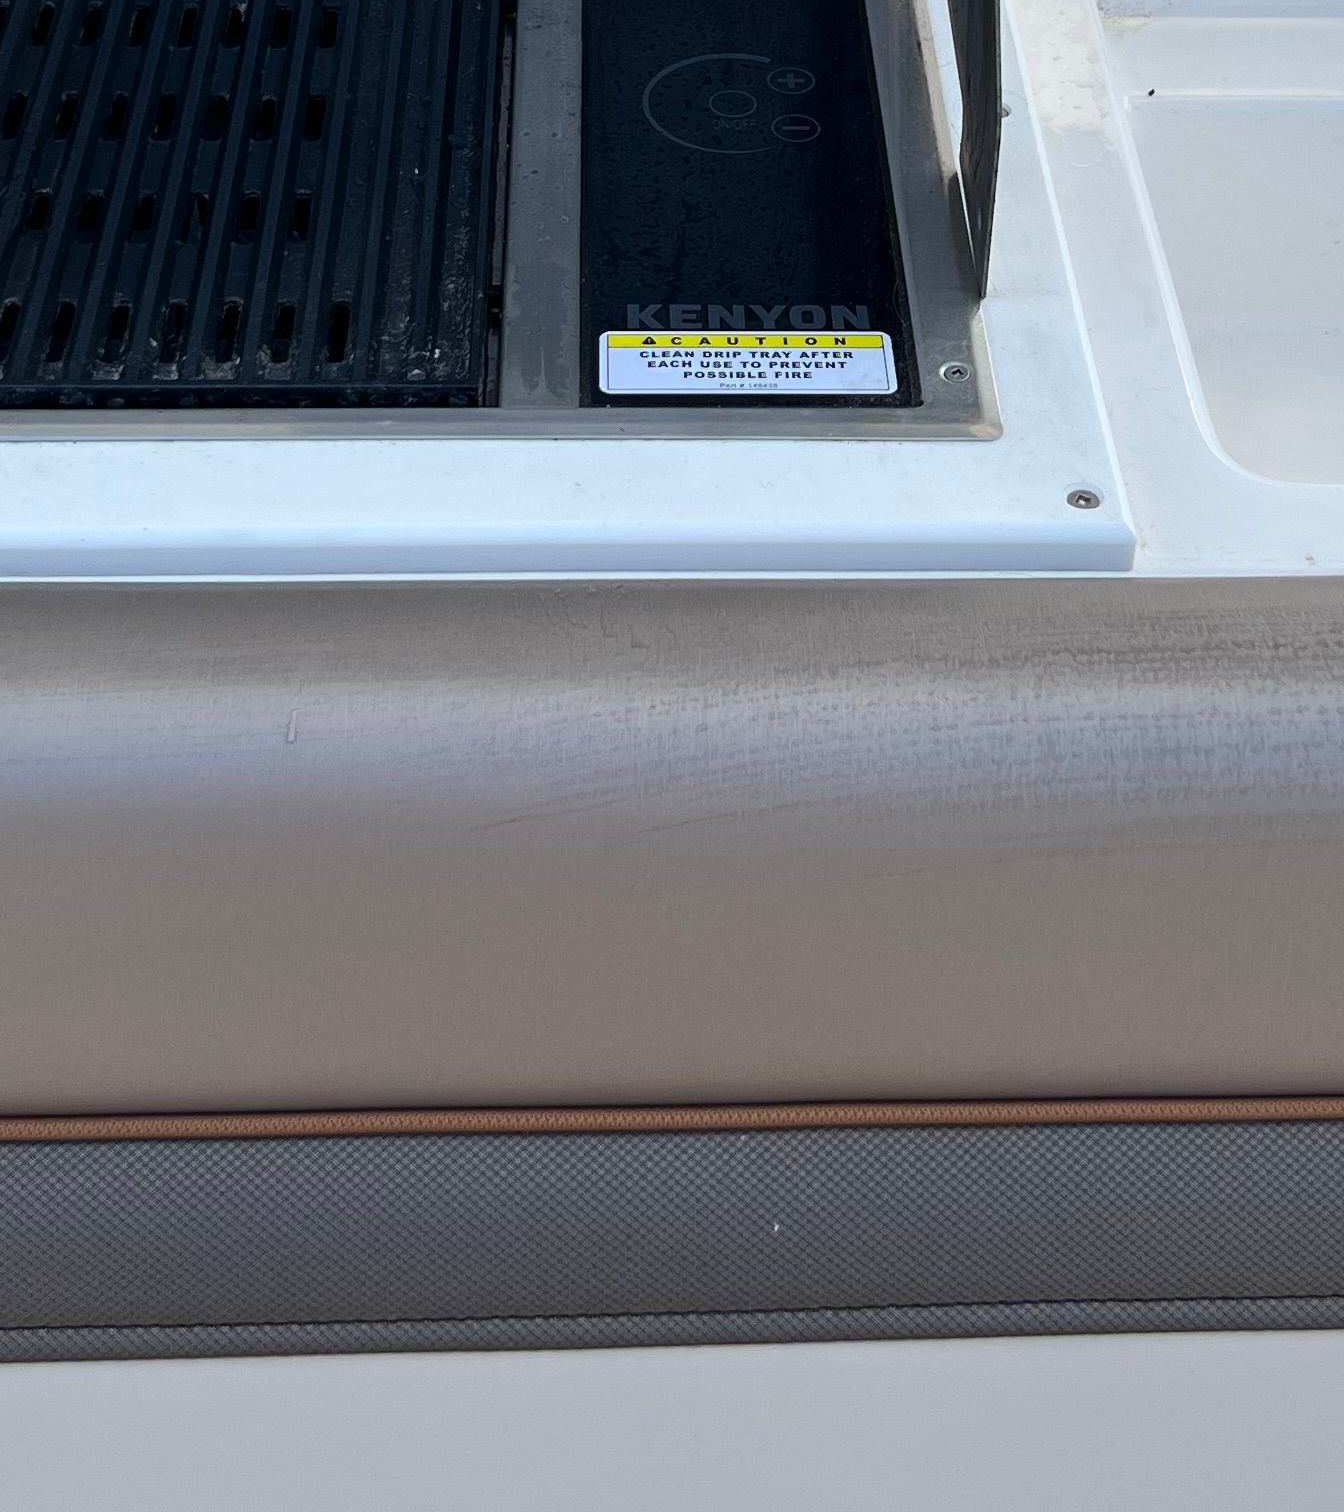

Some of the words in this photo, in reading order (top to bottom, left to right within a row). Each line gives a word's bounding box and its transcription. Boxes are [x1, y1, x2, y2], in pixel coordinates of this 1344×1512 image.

[627, 304, 870, 329] KENYON
[670, 336, 848, 346] CAUTION
[639, 351, 695, 359] CLEAN
[703, 351, 742, 359] DRIP
[750, 351, 792, 359] TRAY
[799, 351, 854, 359] AFTER
[647, 361, 692, 369] EACH
[700, 361, 733, 369] USE
[742, 361, 761, 369] TO
[769, 361, 848, 369] PREVENT
[683, 371, 767, 379] POSSIBLE
[775, 371, 813, 379] FIRE
